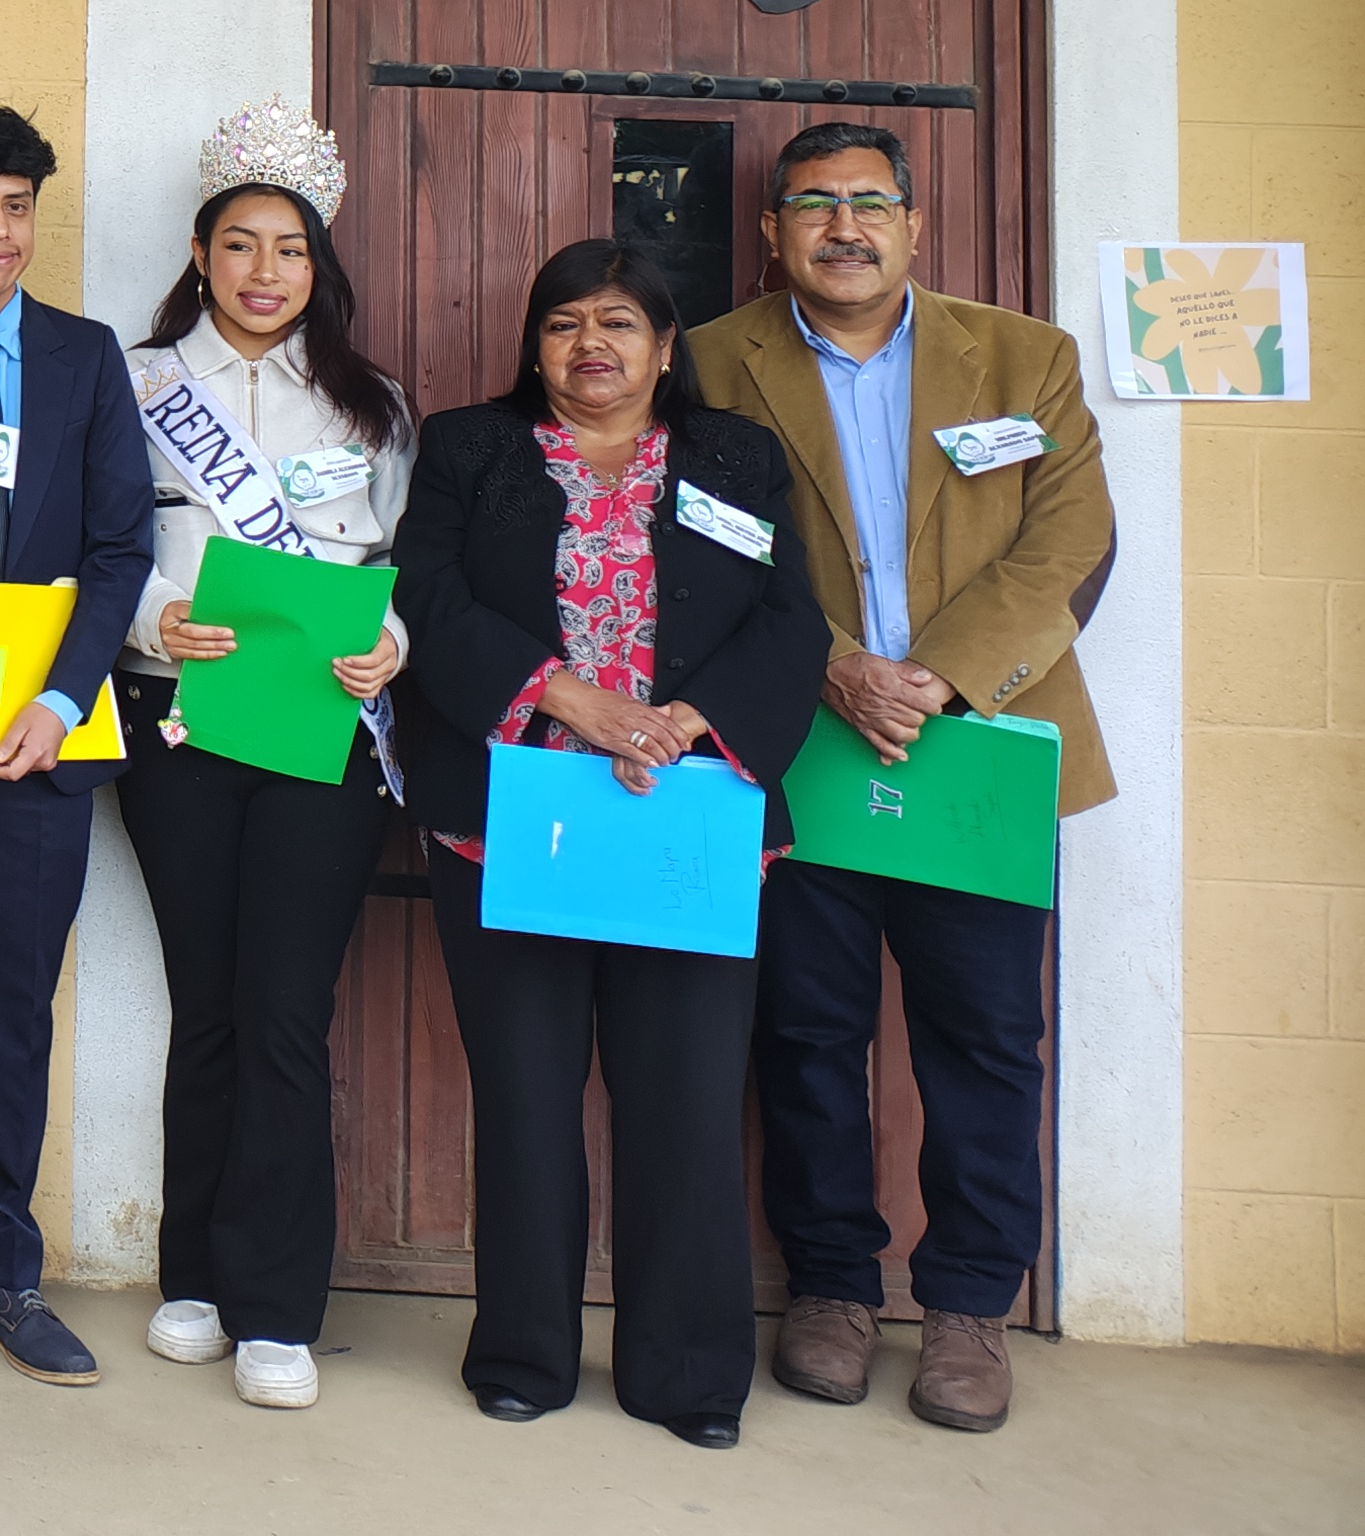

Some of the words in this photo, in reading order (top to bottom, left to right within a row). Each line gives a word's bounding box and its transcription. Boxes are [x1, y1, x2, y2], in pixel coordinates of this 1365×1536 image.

[1177, 302, 1214, 314] AQUELLO
[1217, 299, 1235, 309] QUE
[145, 383, 257, 505] REINA
[867, 778, 904, 819] 17
